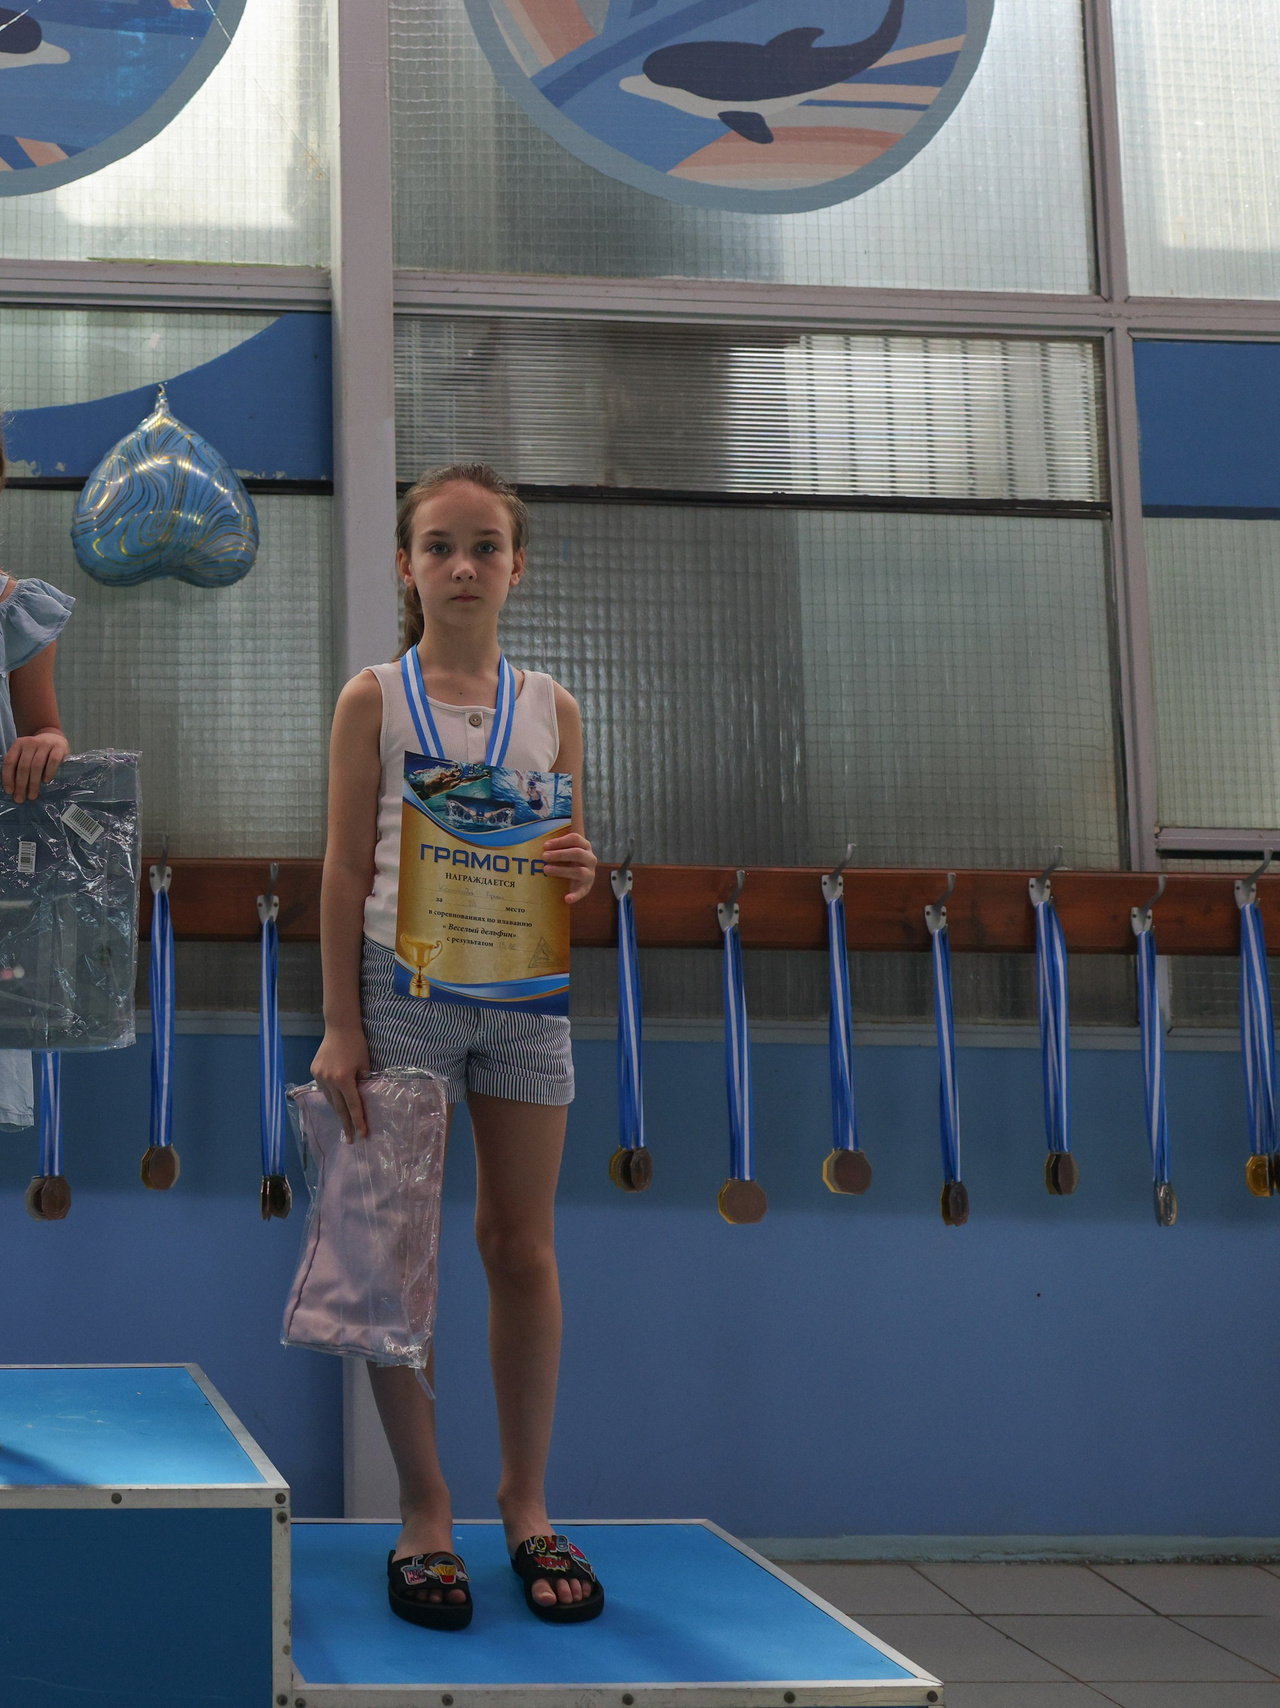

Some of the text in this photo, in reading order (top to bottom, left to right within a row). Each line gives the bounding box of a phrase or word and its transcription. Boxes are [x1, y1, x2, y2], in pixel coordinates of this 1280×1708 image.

[420, 844, 549, 876] ГРАМОТА
[446, 873, 515, 887] НАГРАЖДАЕТСЯ
[434, 910, 485, 923] соревнованиях
[496, 918, 533, 928] плаванию
[448, 924, 479, 935] Веселый
[481, 928, 517, 939] дельфин»
[451, 936, 494, 947] результатом
